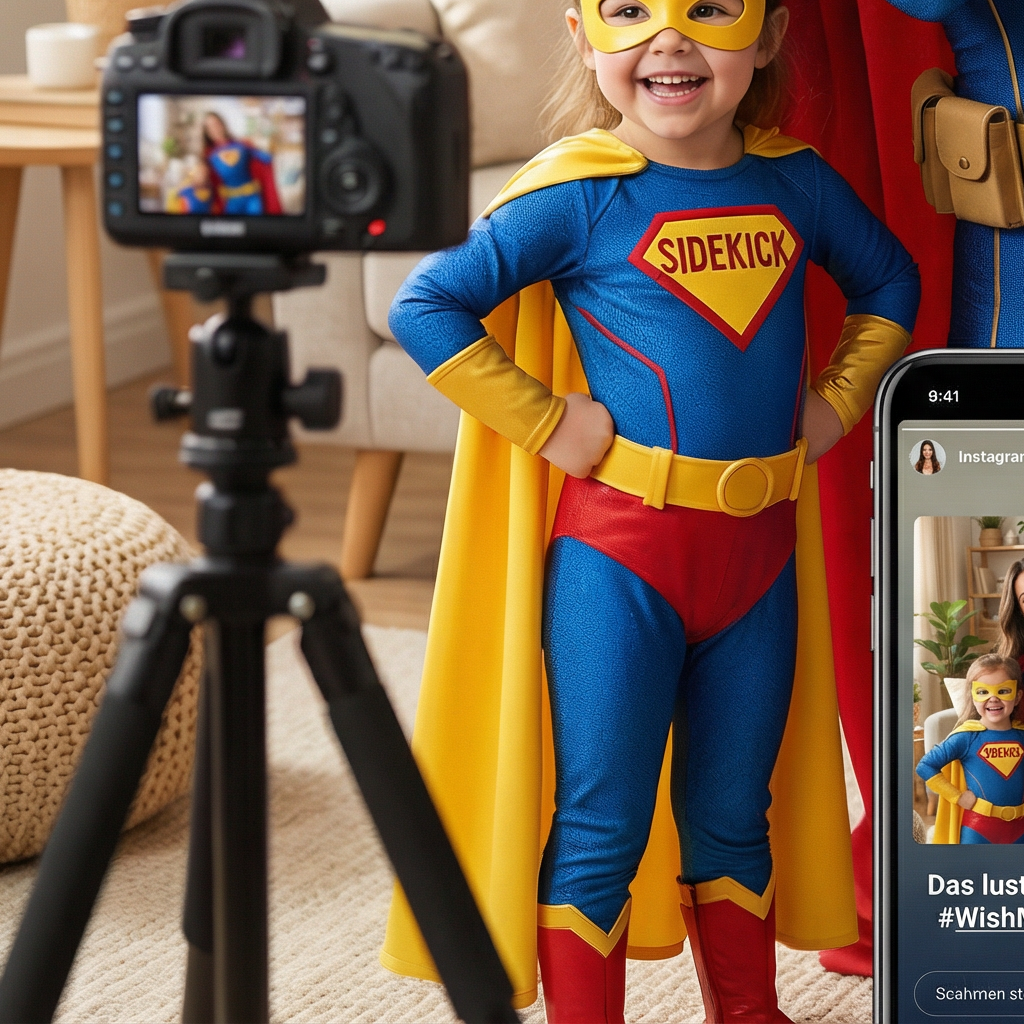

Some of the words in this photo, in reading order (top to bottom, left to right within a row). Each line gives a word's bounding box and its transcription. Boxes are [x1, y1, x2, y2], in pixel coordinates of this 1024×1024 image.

[657, 229, 790, 275] SIDEKICK
[928, 389, 960, 403] 9:41
[928, 873, 975, 896] Das
[935, 986, 1006, 1001] Scahmen
